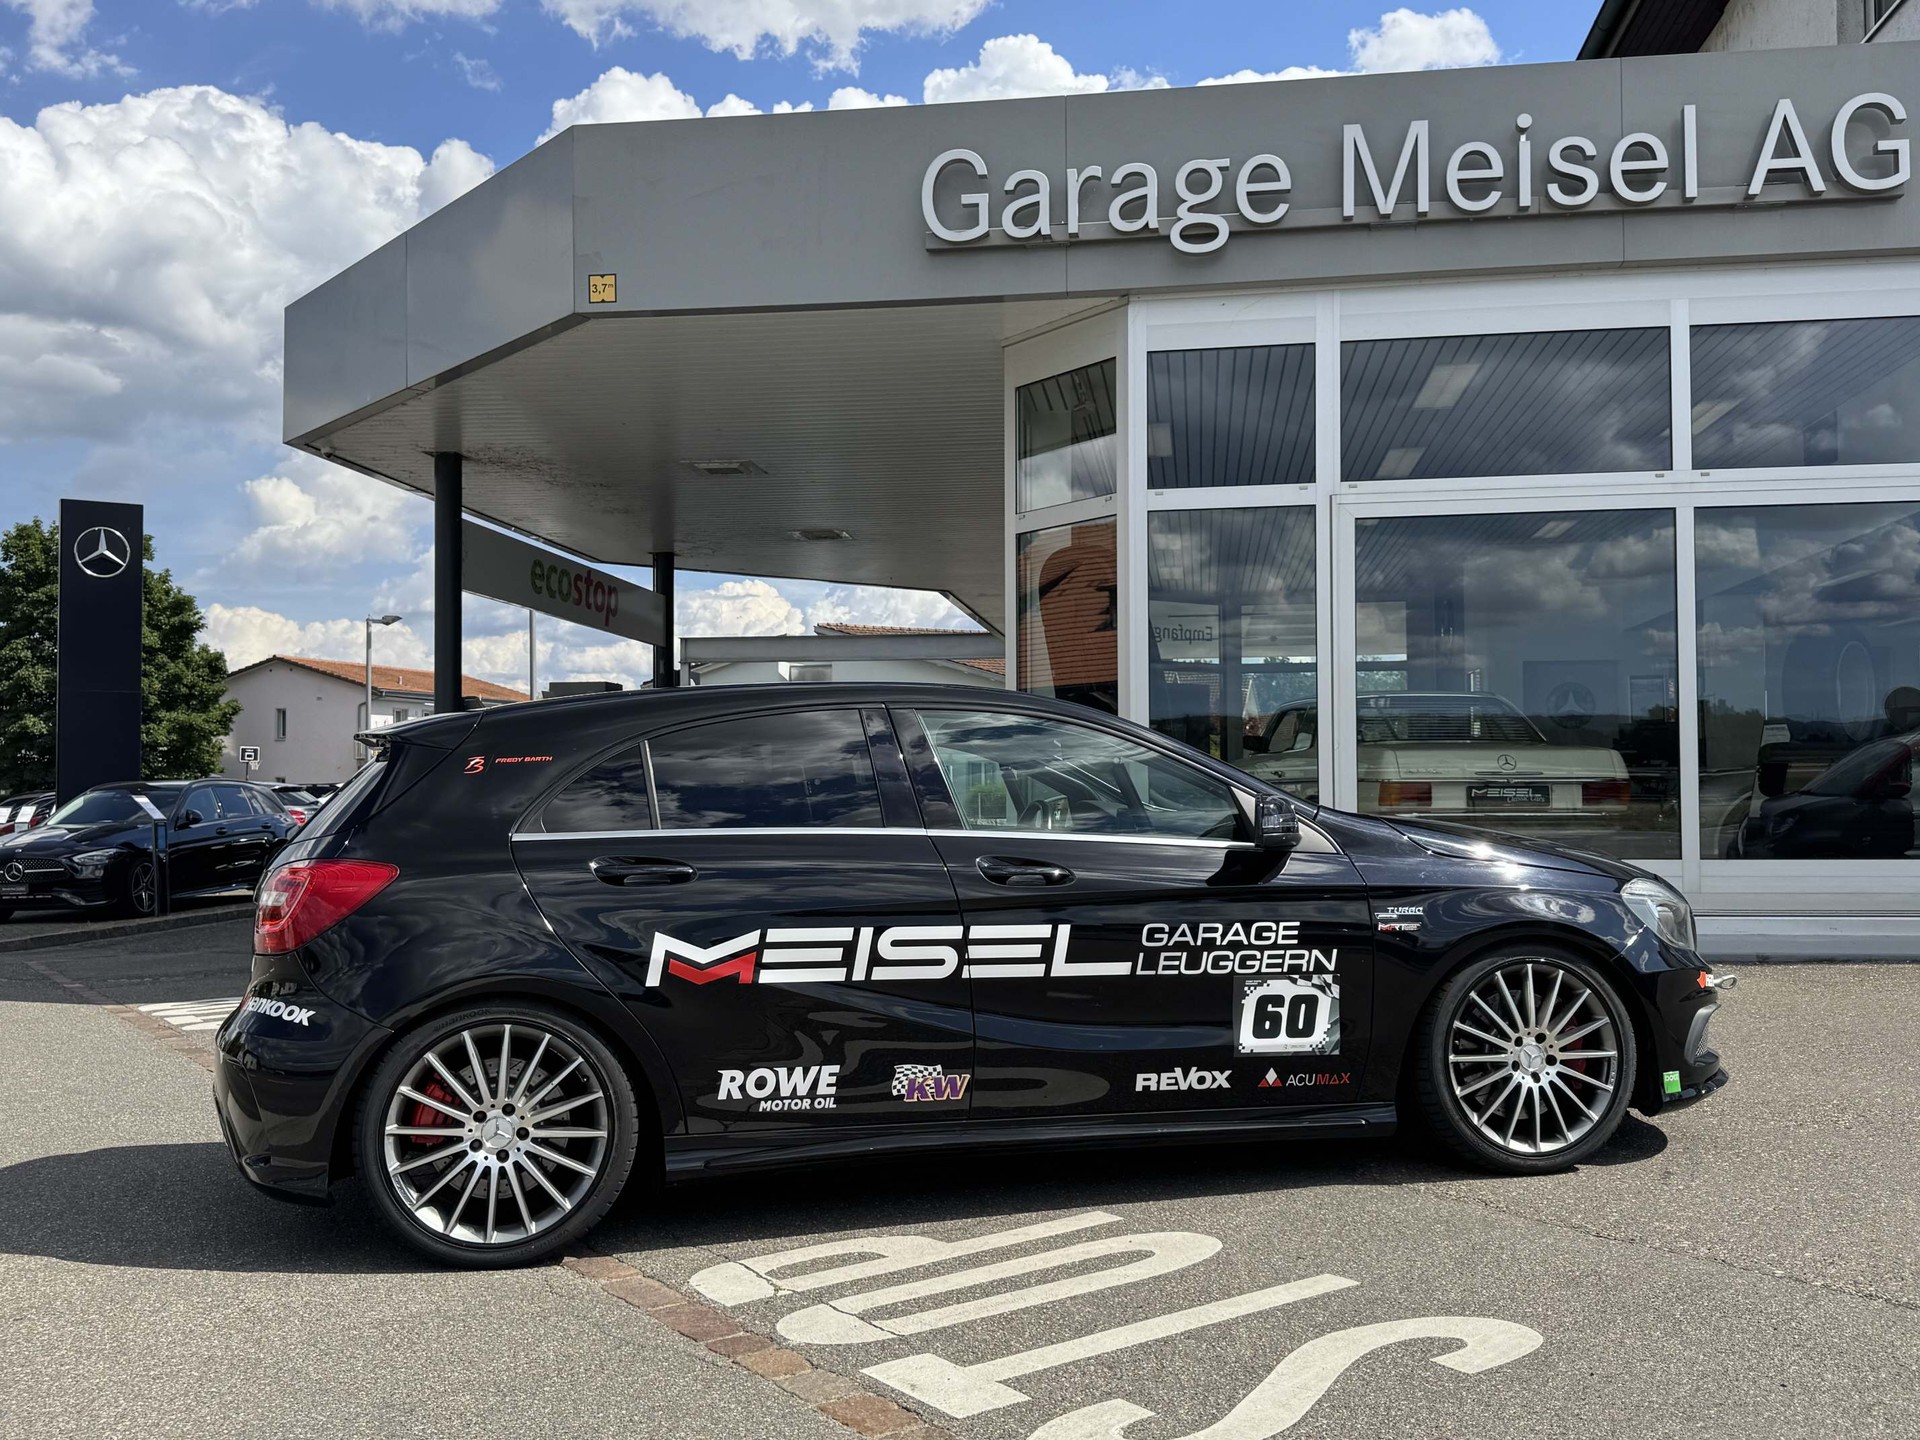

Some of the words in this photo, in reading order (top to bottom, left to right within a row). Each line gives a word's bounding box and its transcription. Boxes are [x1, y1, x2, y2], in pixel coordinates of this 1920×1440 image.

[921, 148, 1292, 253] Garage
[1342, 102, 1698, 220] Meisel
[1746, 92, 1911, 199] AG
[530, 558, 619, 627] ecostop
[1471, 788, 1542, 797] MEISEL
[1387, 906, 1423, 915] TURBO
[1141, 921, 1301, 947] GARAGE
[645, 924, 1133, 987] MEISEL
[1135, 948, 1338, 975] LEUGGERN
[1252, 994, 1319, 1039] 60
[717, 1064, 841, 1100] ROWE
[904, 1073, 971, 1103] KW
[1285, 1072, 1351, 1087] ACUMAX
[758, 1098, 811, 1112] MOTOR
[814, 1097, 837, 1110] OIL
[689, 1210, 1544, 1440] STOP
